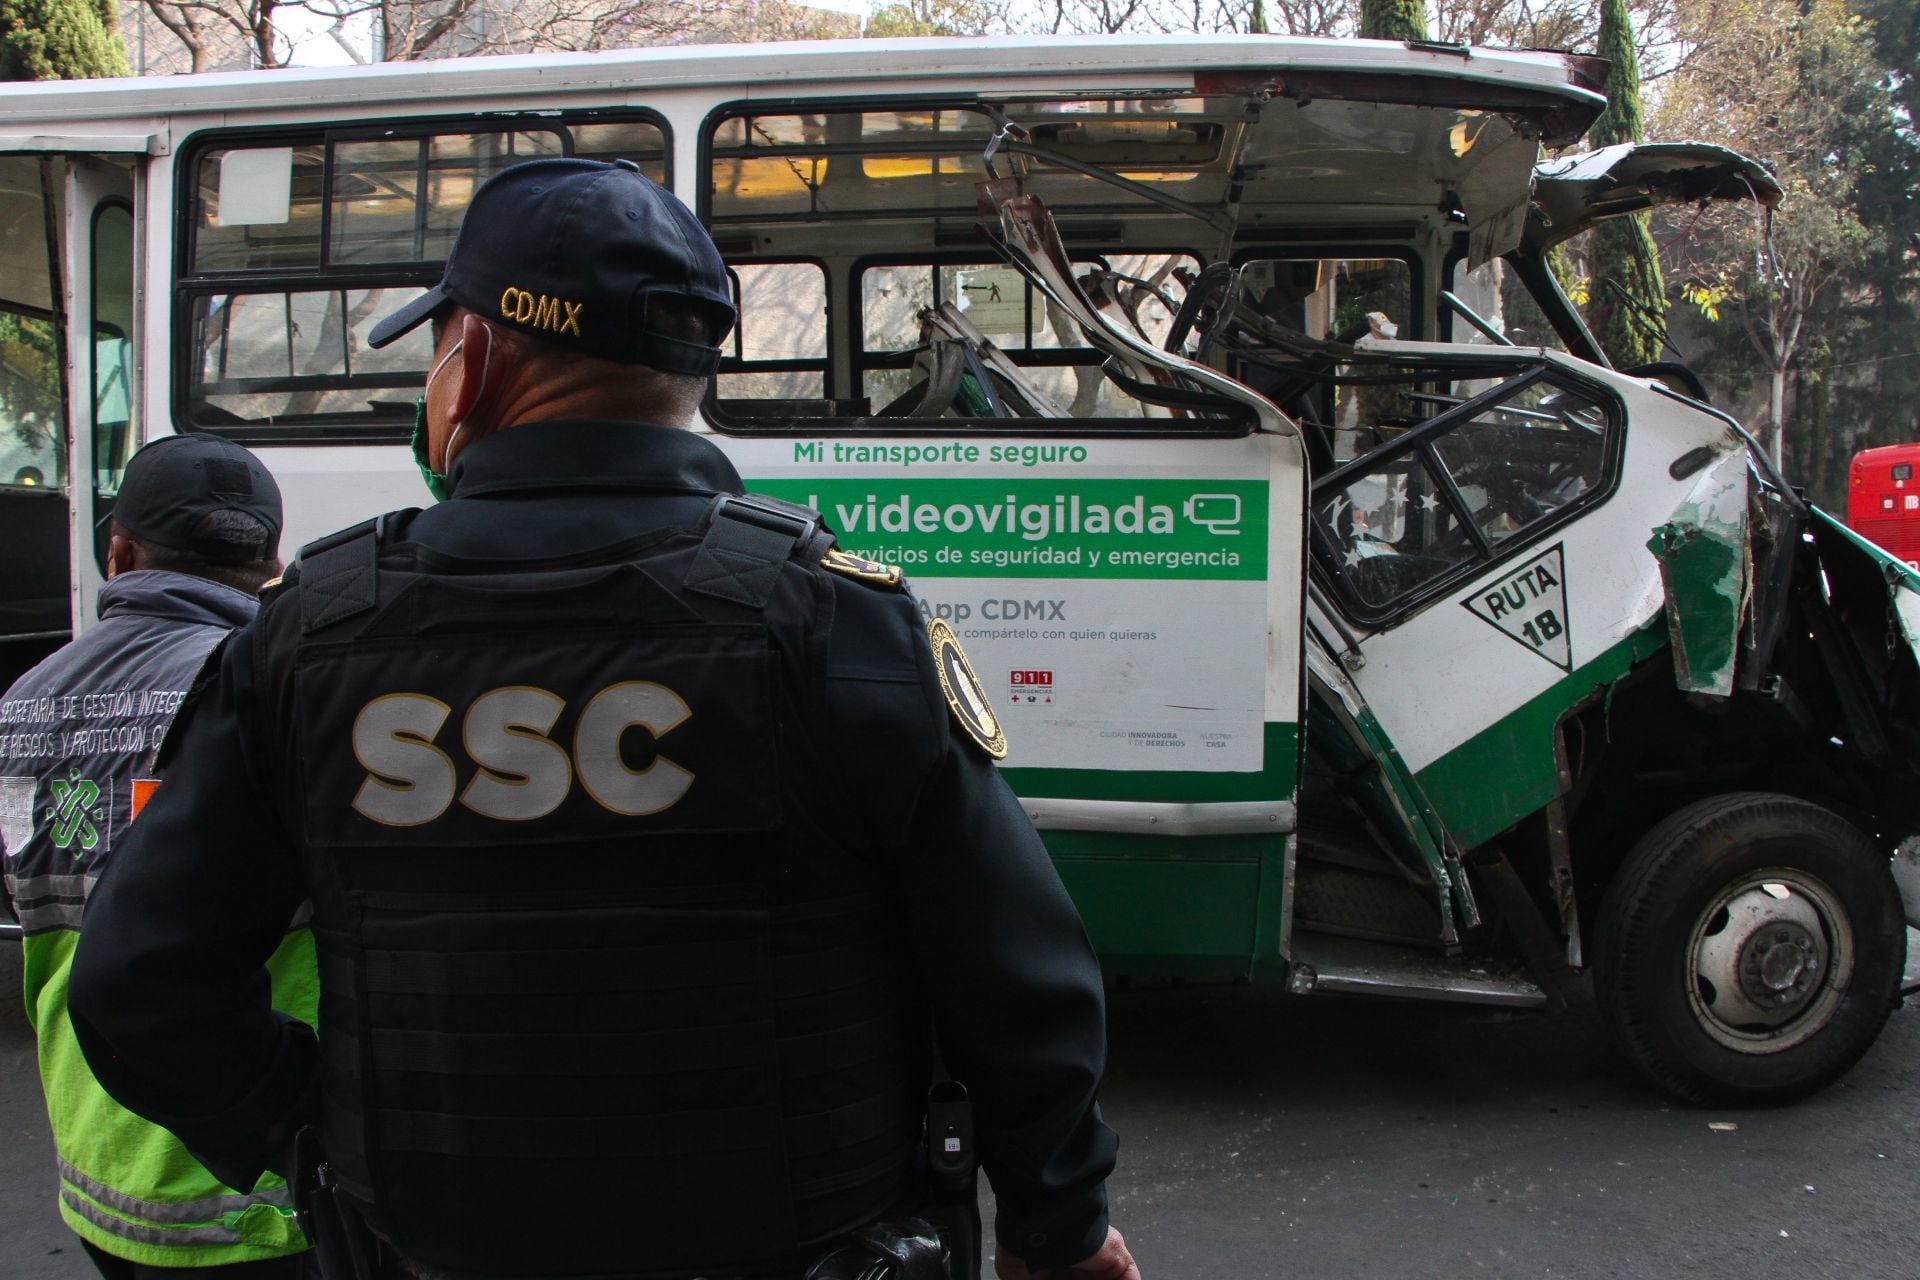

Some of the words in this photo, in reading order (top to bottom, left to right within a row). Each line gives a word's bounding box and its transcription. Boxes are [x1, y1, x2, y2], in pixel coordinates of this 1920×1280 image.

[501, 286, 583, 337] CDMX
[793, 442, 825, 463] Mi
[833, 442, 980, 467] transporte
[989, 445, 1088, 467] seguro
[835, 494, 1175, 541] videovigilada
[935, 546, 963, 565] de
[970, 546, 1081, 568] seguridad
[1088, 550, 1101, 568] y
[1108, 548, 1241, 569] emergencia
[919, 598, 972, 624] App
[980, 599, 1067, 622] CDMX
[1484, 564, 1559, 621] RUTA
[964, 628, 1038, 641] compártelo
[1042, 630, 1066, 640] con
[1069, 628, 1106, 642] quien
[1109, 628, 1157, 642] quieras
[1522, 609, 1563, 648] 18
[1012, 672, 1050, 684] 911
[61, 695, 78, 719] DE
[83, 682, 136, 719] GESTIÓN
[137, 690, 188, 717] INTEGR
[10, 732, 55, 760] RIESGOS
[60, 732, 70, 759] Y
[70, 718, 147, 756] PROTECCIÓN
[351, 680, 696, 826] SSC
[1206, 741, 1227, 749] CASA
